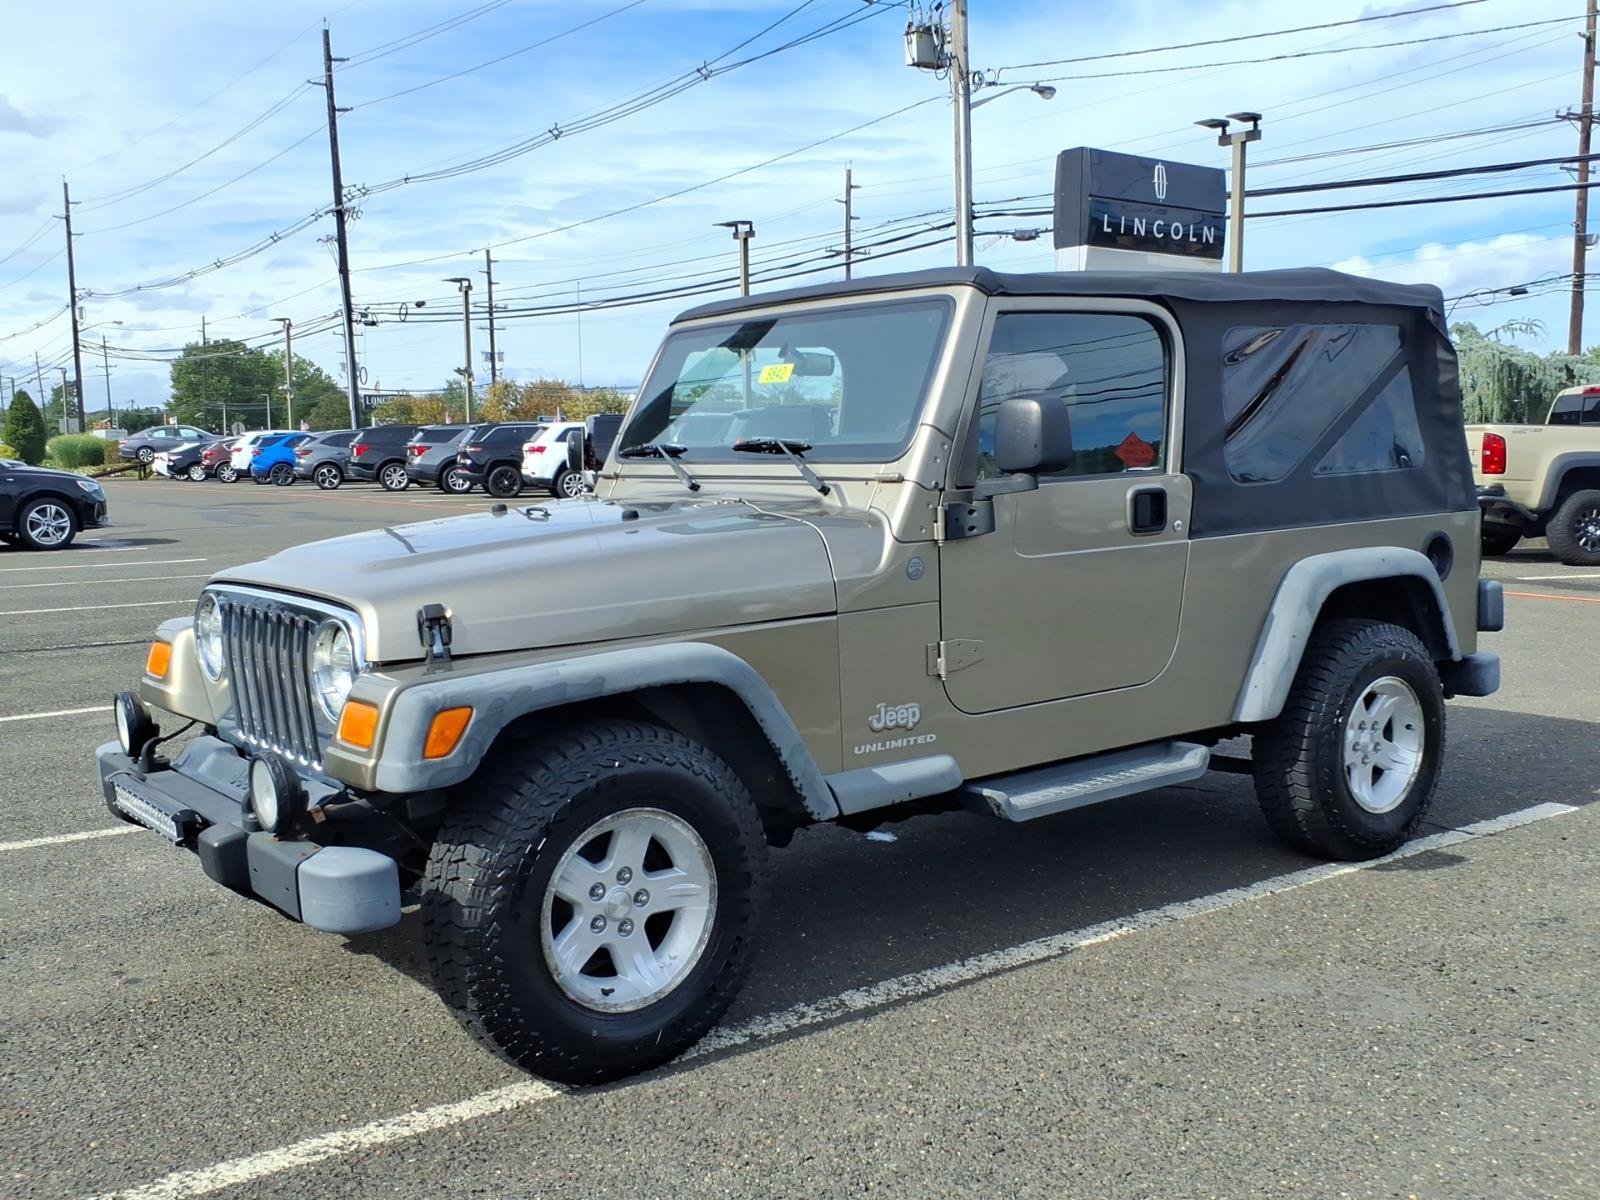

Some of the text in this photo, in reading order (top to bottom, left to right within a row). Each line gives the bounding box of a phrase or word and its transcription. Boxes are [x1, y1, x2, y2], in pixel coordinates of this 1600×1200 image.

[1103, 214, 1215, 244] LINCOLN
[868, 703, 920, 731] Jeep
[854, 734, 936, 754] UNLIMITED
